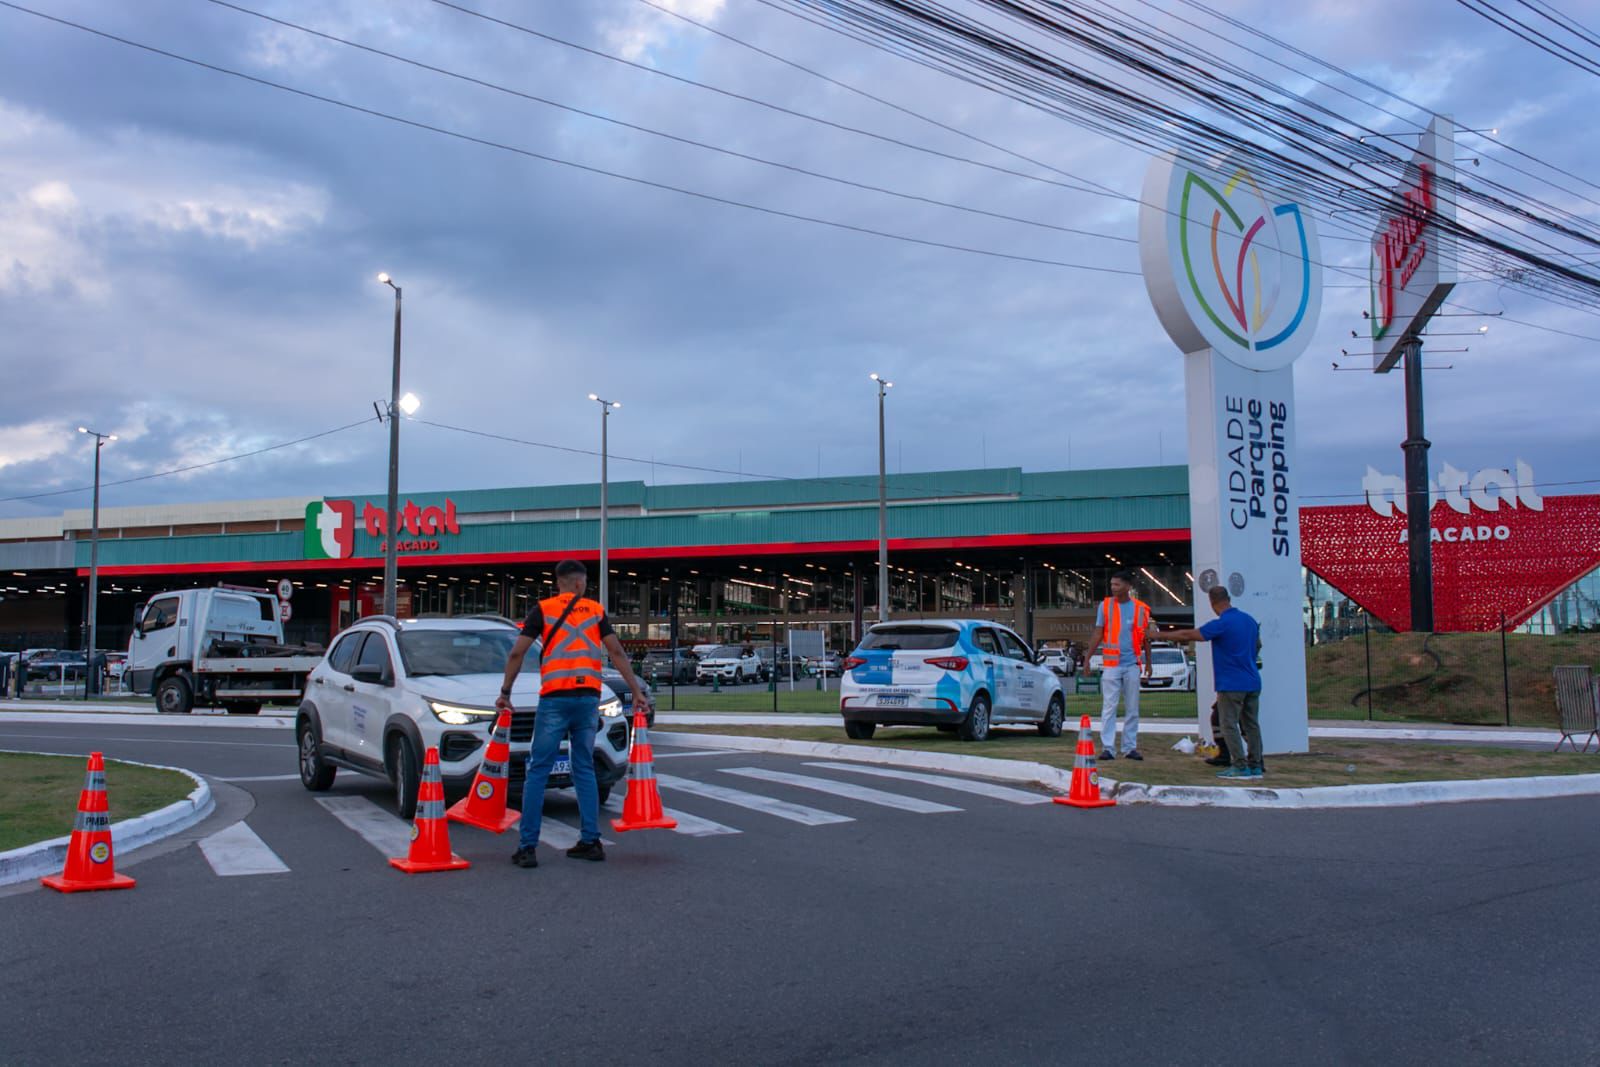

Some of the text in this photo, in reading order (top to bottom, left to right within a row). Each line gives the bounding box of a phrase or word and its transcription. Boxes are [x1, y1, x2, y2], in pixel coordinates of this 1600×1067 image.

[1226, 395, 1248, 530] CIDADE
[1248, 398, 1267, 519] Parque
[1268, 400, 1290, 557] Shopping
[381, 540, 439, 552] AACADO
[1399, 525, 1511, 543] AACADO
